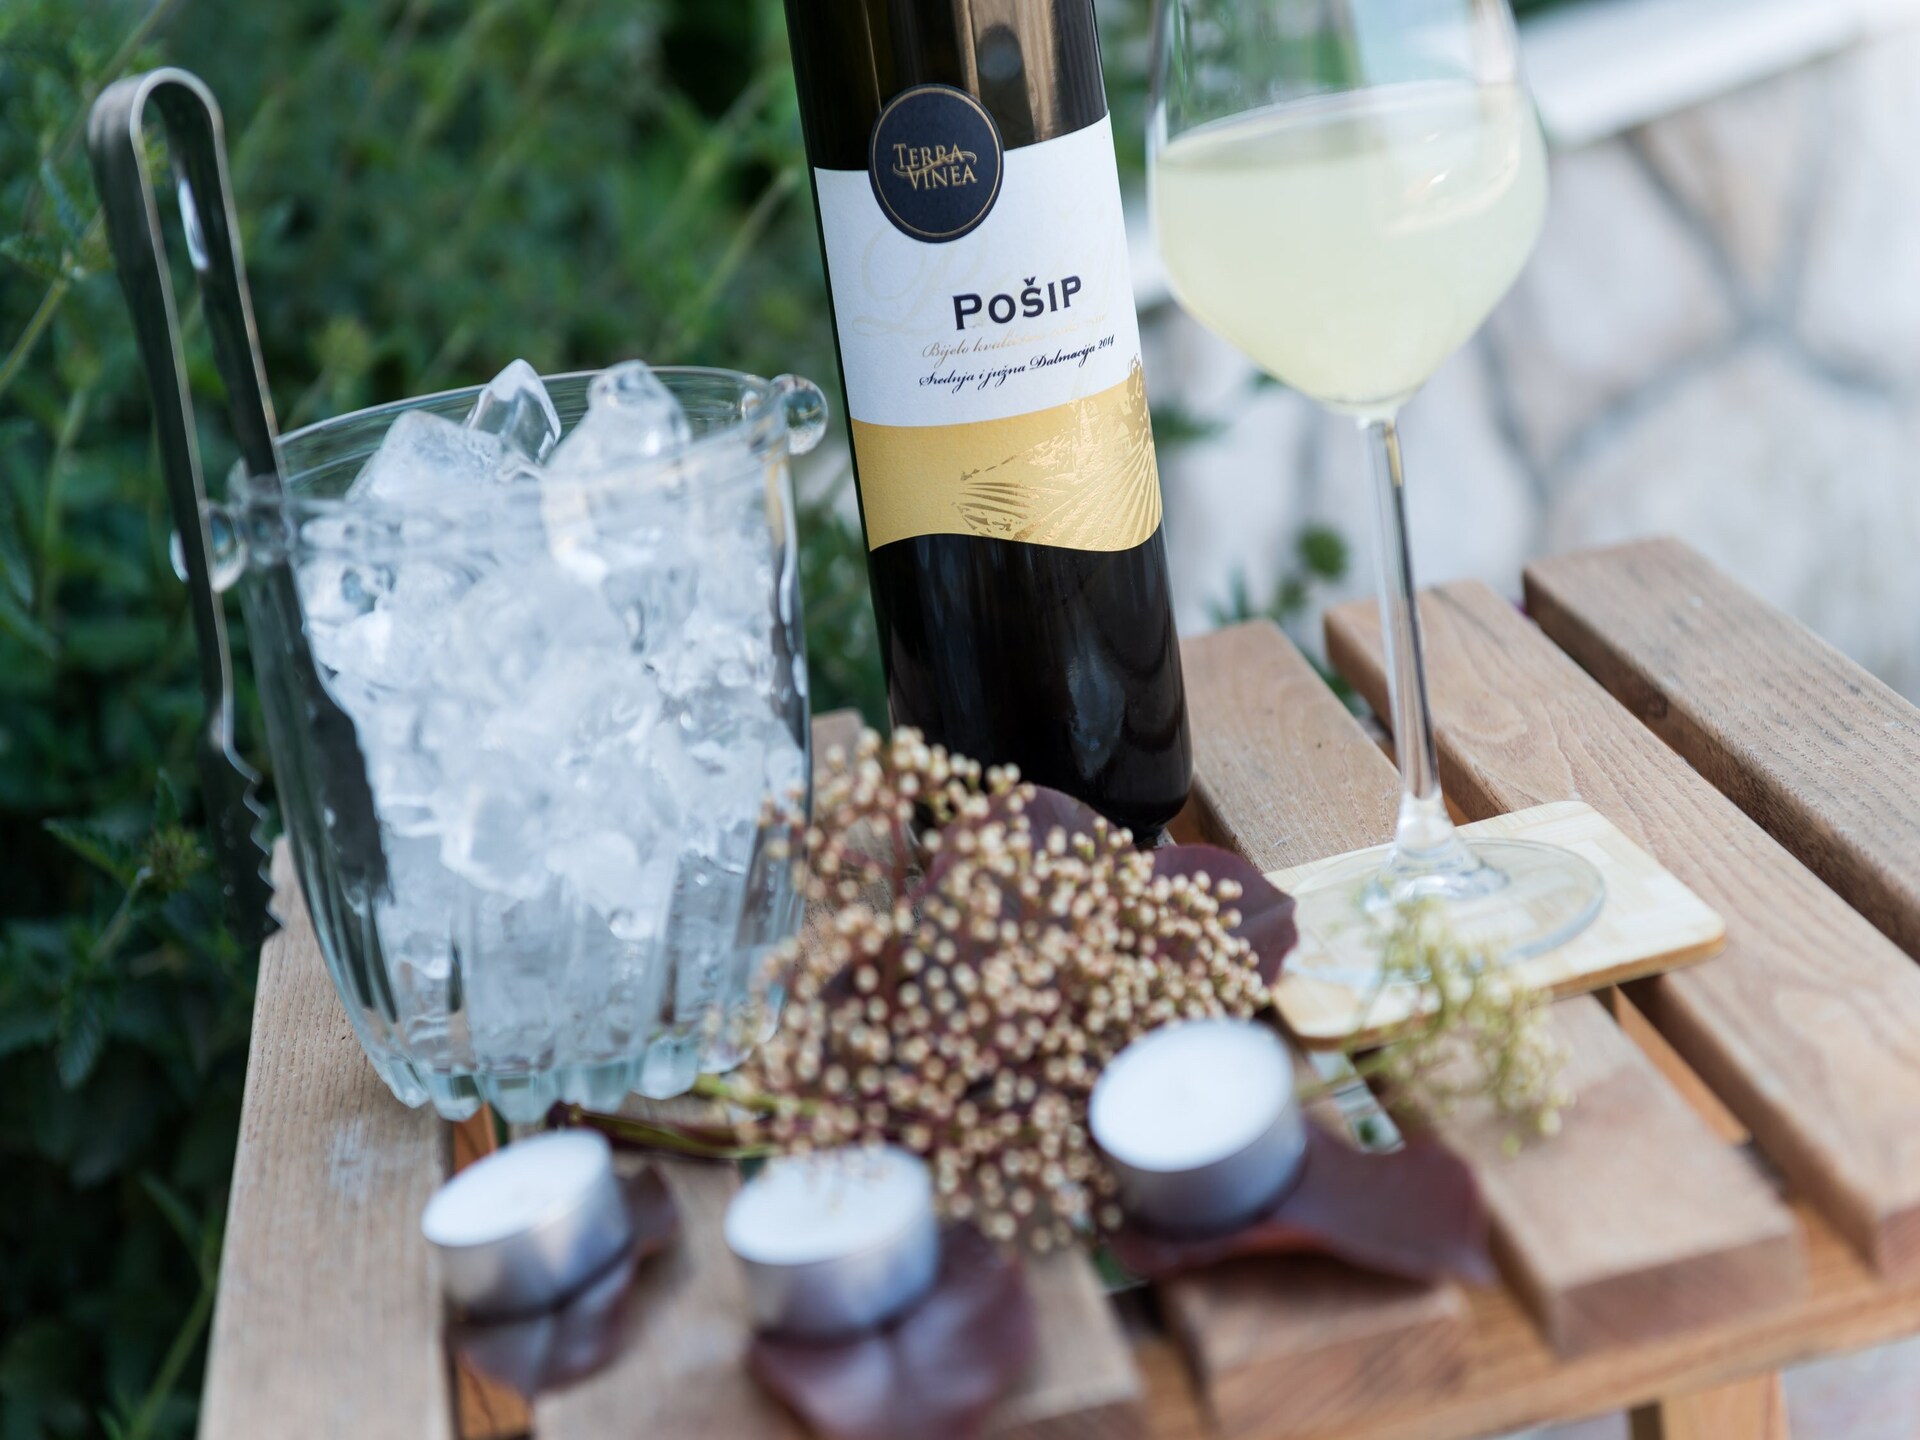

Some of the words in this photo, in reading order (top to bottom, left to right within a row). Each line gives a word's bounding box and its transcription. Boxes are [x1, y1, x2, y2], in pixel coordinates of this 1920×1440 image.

[893, 142, 965, 169] TERRA
[906, 164, 977, 190] VINEA
[953, 276, 1082, 330] POŠIP
[922, 338, 969, 368] Bijelo
[919, 369, 975, 394] Srednja
[977, 365, 1026, 391] južna
[1029, 343, 1096, 370] Dalmacija
